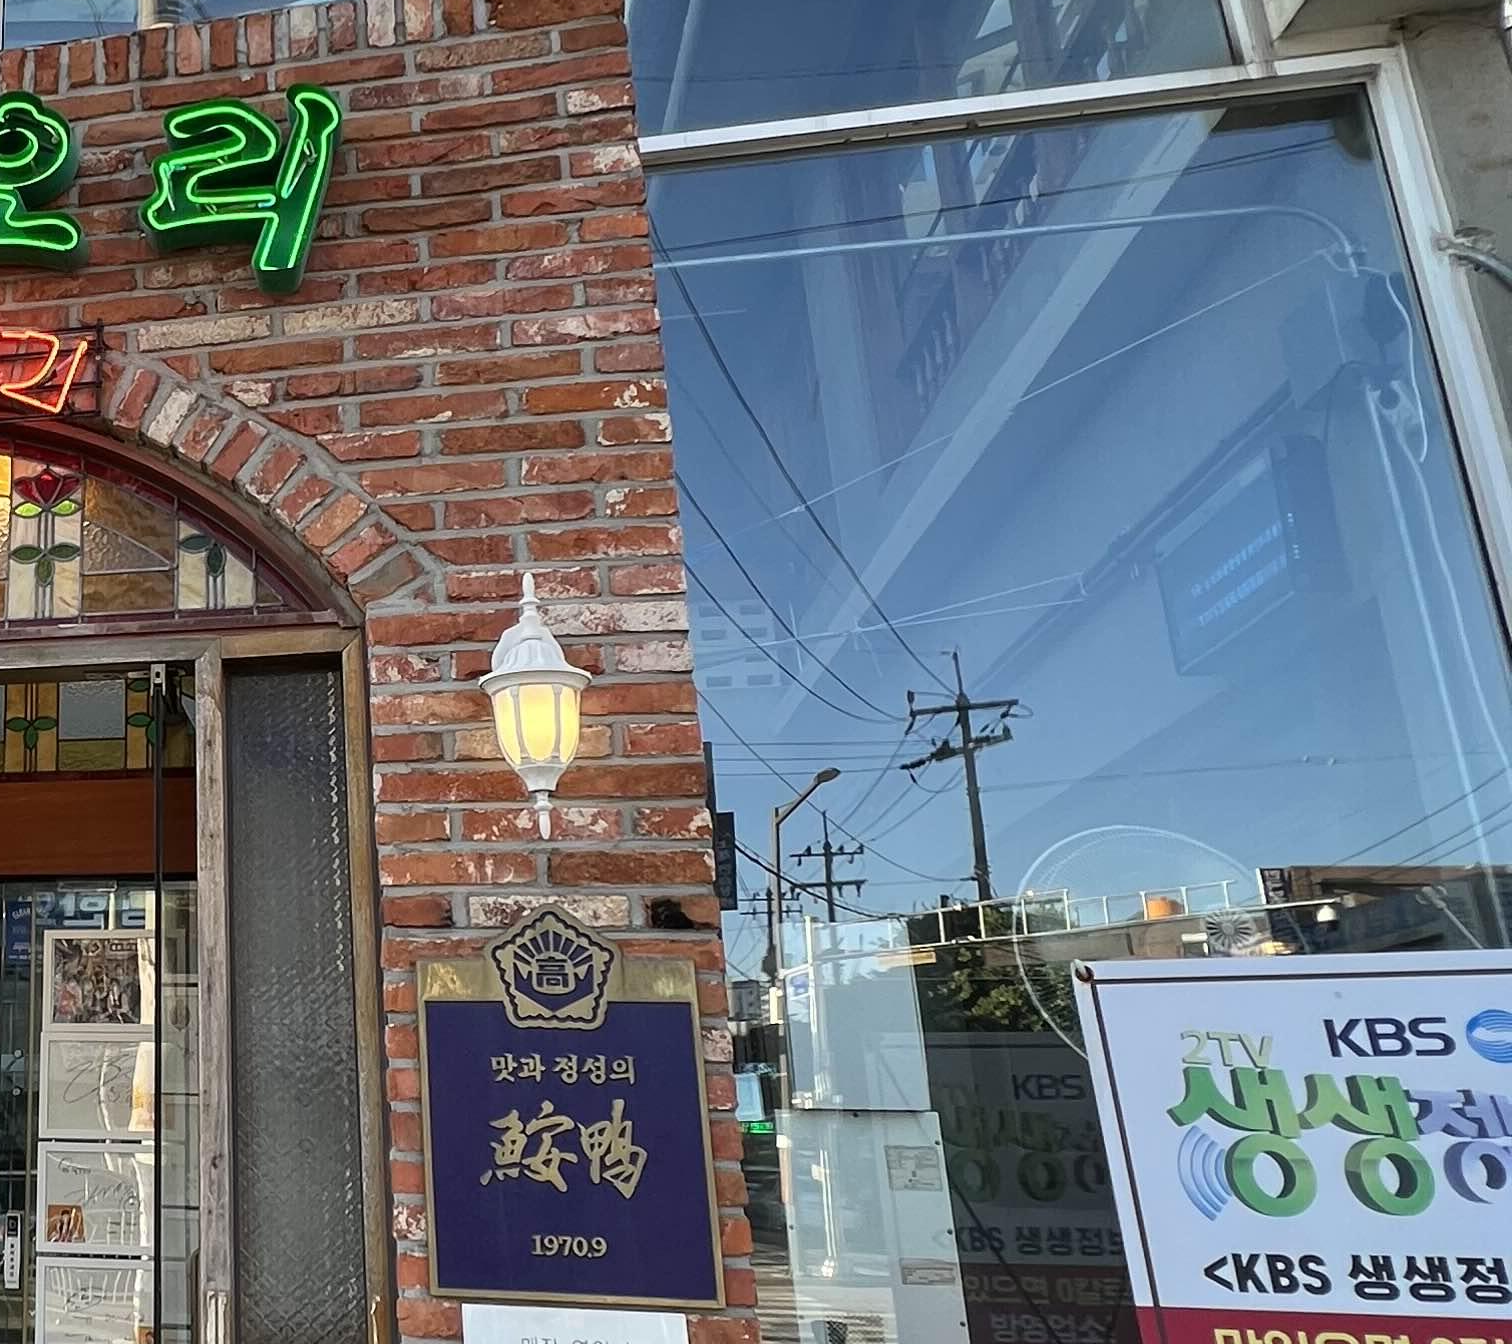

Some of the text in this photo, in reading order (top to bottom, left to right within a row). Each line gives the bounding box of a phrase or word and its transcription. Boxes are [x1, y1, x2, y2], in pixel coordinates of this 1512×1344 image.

[1179, 1029, 1274, 1070] 2TV
[1323, 1016, 1457, 1058] KBS
[490, 1054, 637, 1086] 맛과 정성의
[530, 1233, 609, 1260] 1970.9
